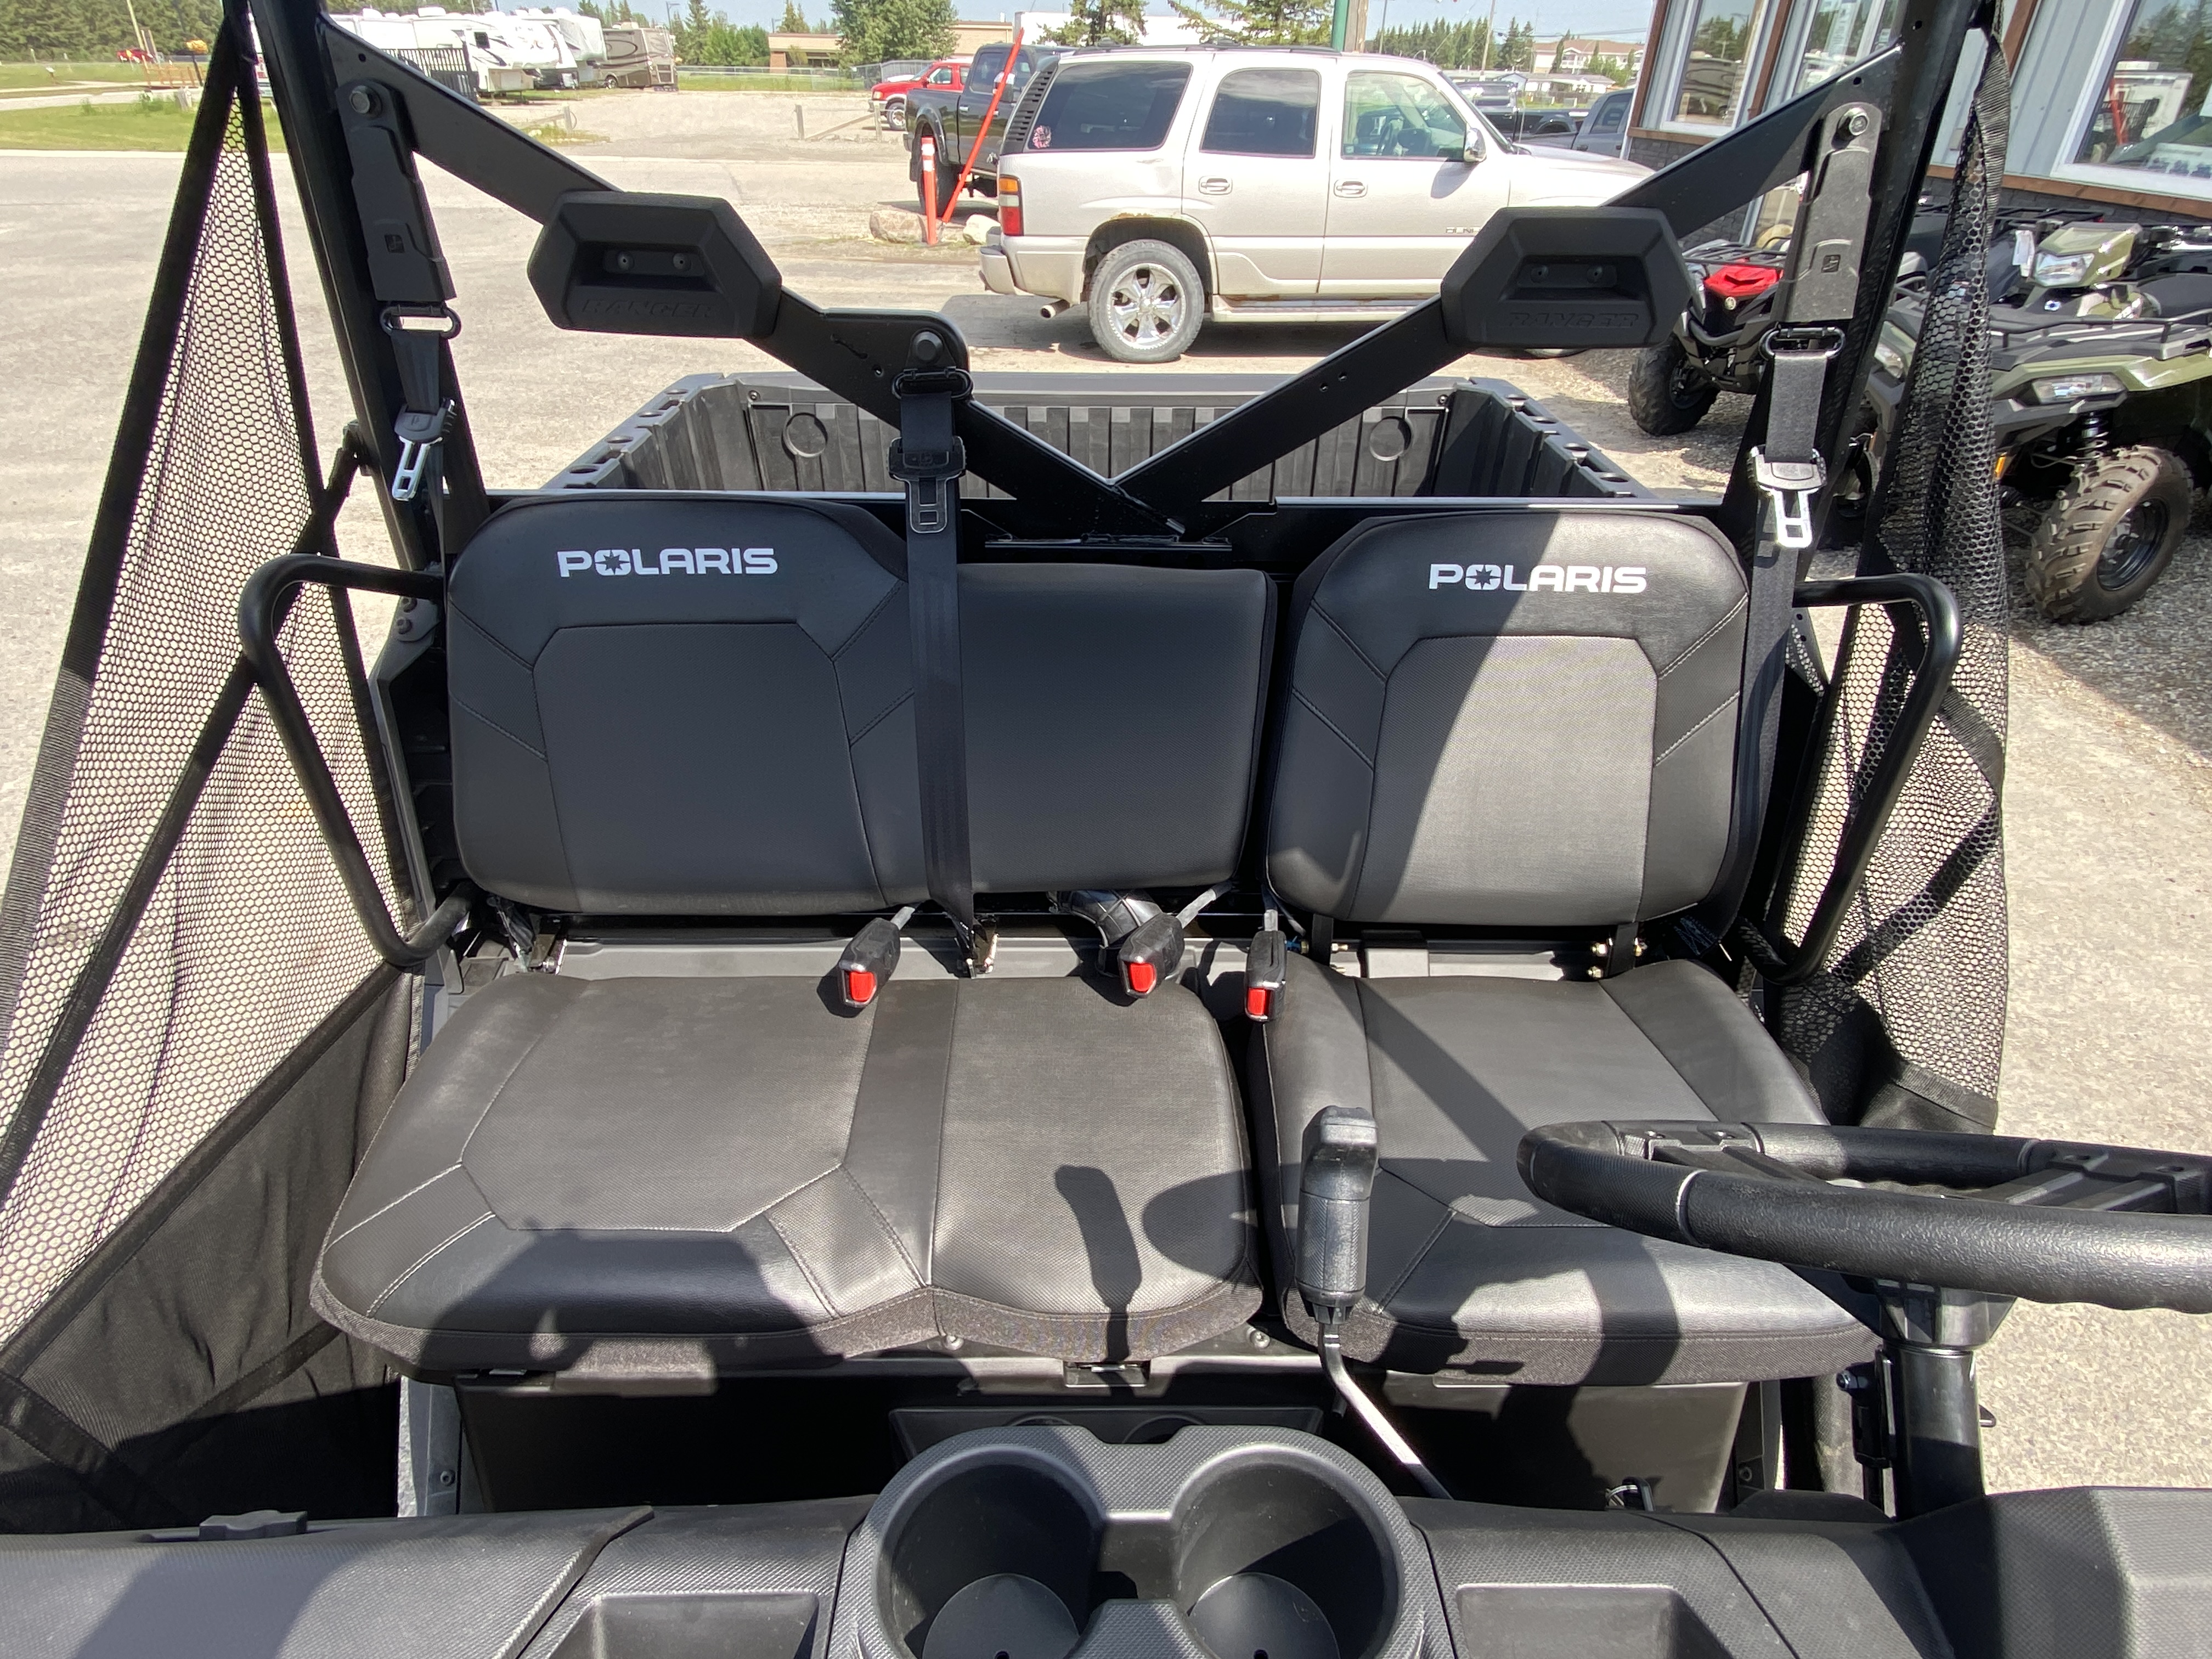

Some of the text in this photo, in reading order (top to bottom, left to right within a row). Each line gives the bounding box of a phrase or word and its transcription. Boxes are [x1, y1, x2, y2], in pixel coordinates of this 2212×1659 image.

[581, 298, 715, 318] RANGER
[1509, 312, 1640, 328] RANGER
[556, 547, 778, 578] POLARIS
[1428, 563, 1648, 594] POLARIS
